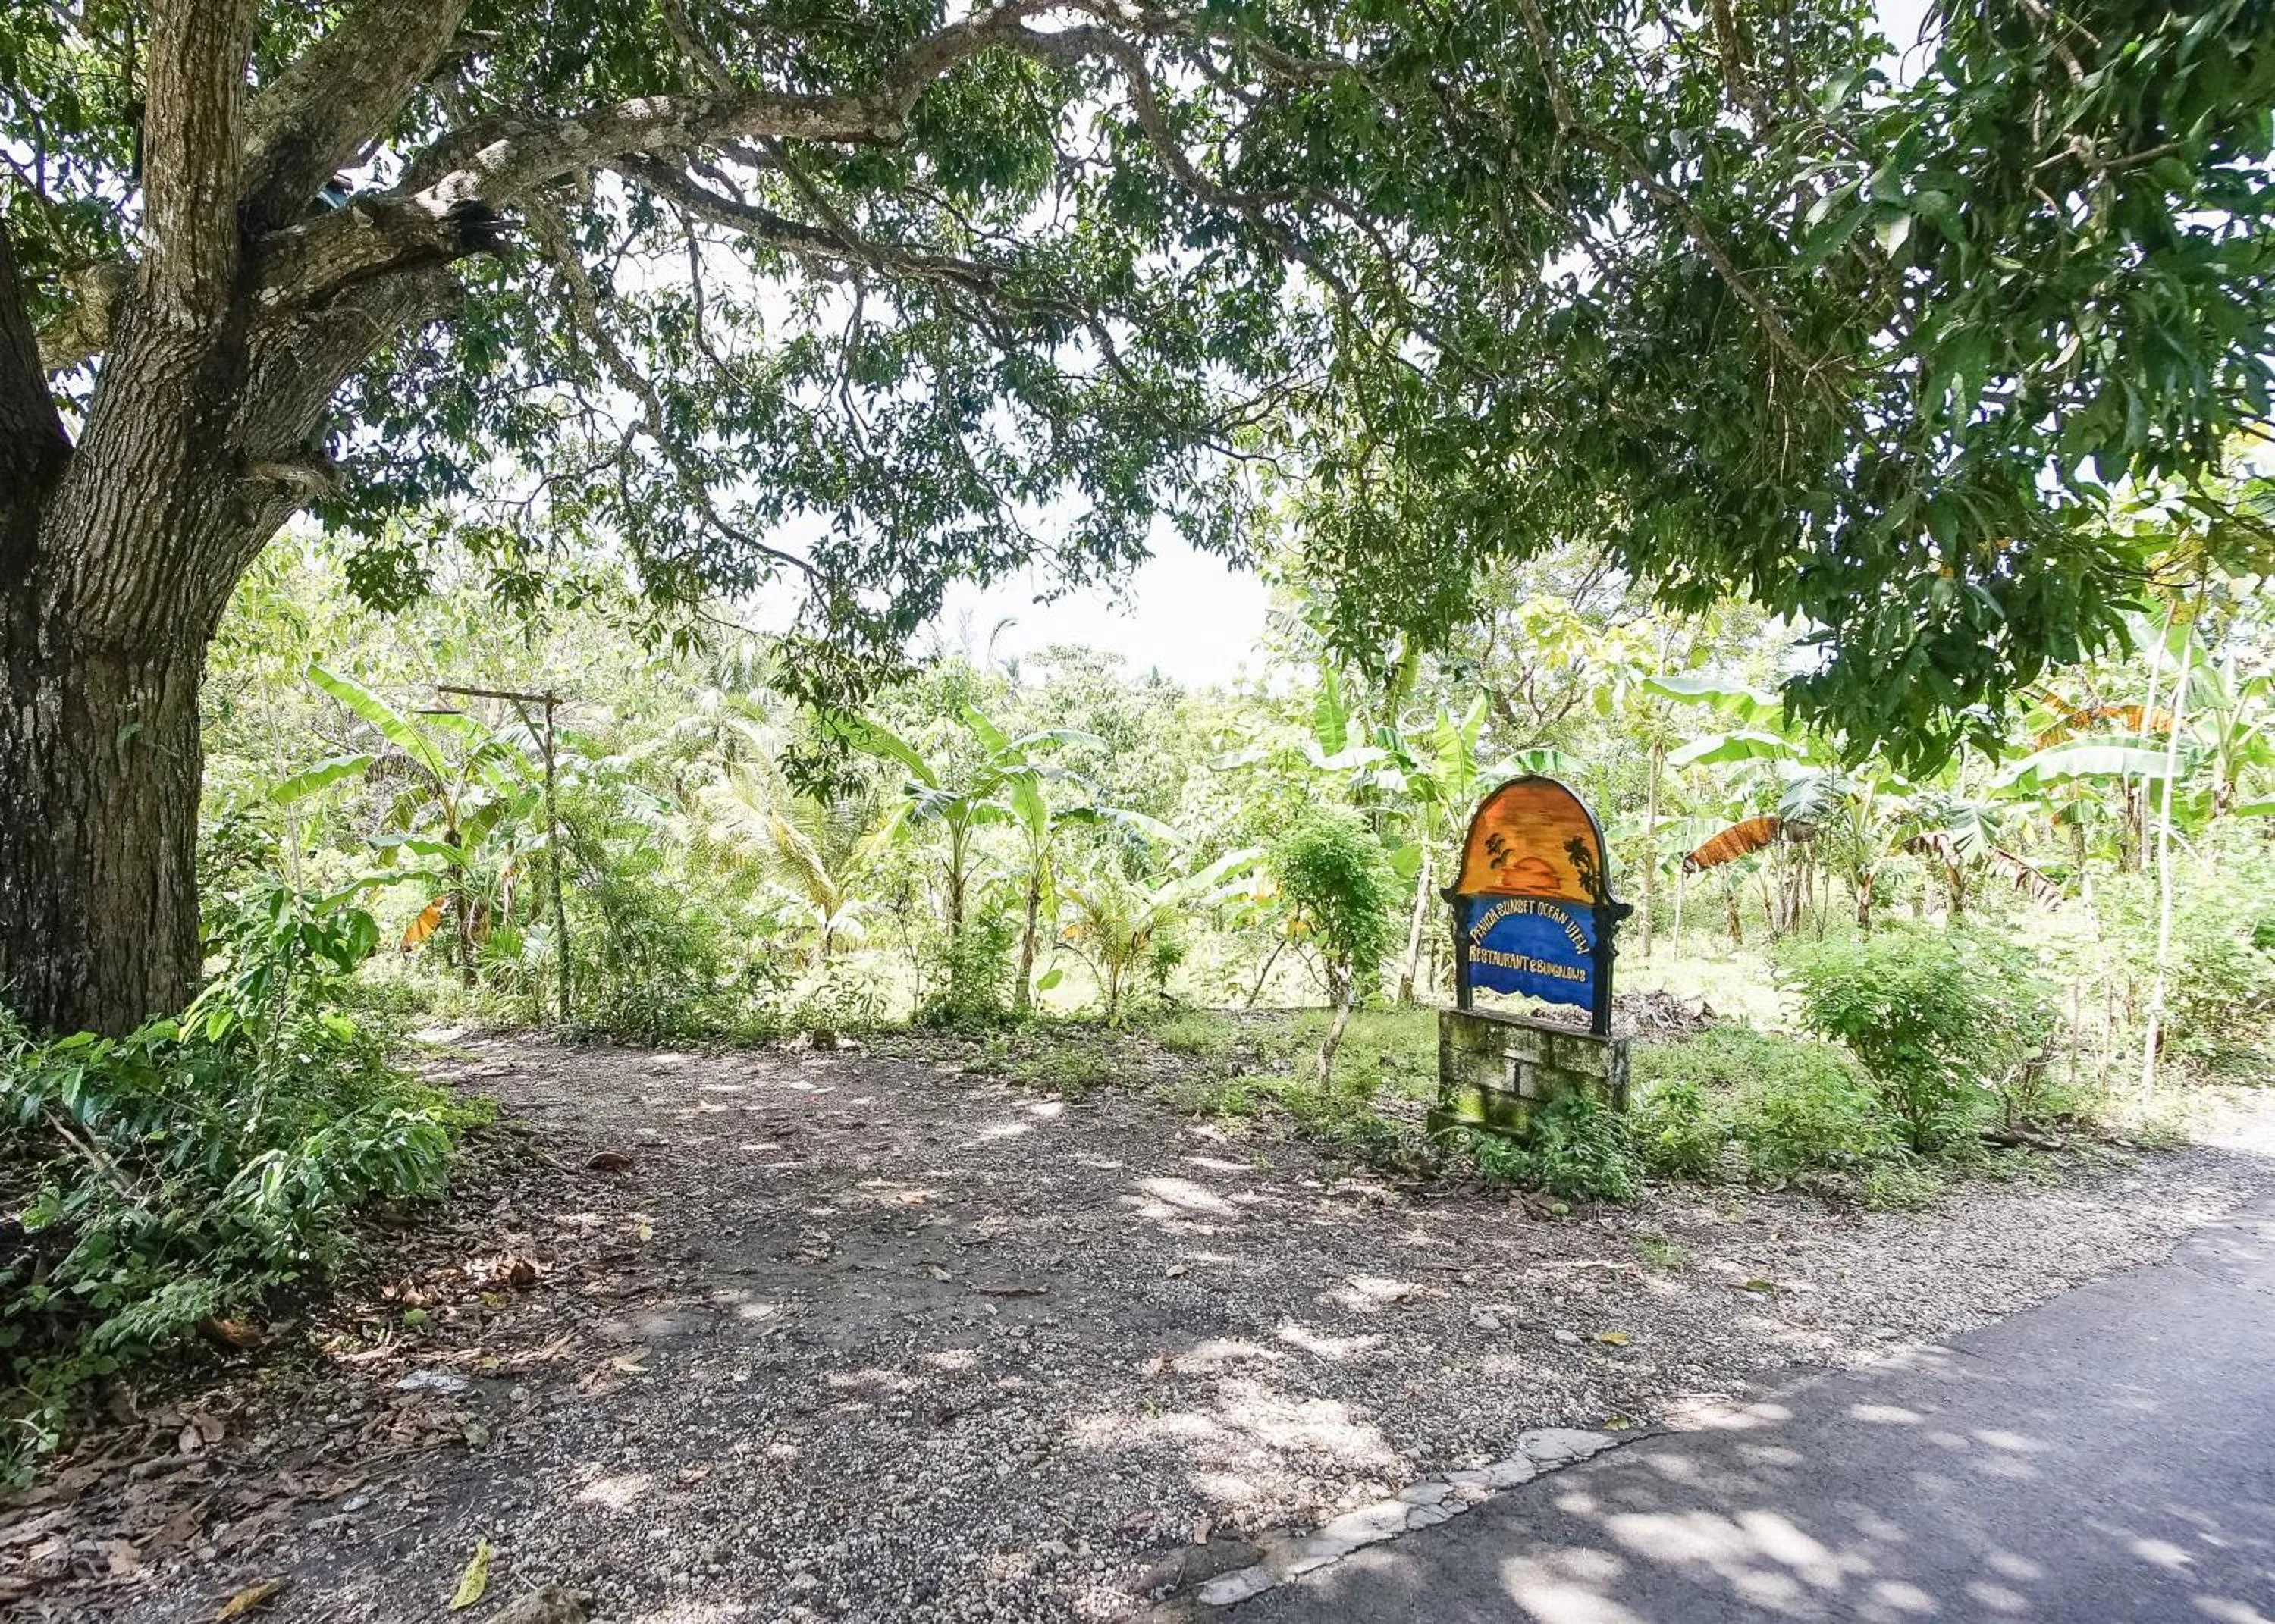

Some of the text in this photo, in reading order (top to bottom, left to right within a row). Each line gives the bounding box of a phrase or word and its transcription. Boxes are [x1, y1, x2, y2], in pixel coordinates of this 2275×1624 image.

[1496, 898, 1536, 917] SUNSET
[1537, 901, 1569, 925] OCEAN
[1564, 920, 1590, 955] VIEW
[1469, 945, 1530, 971] RESTAURANT
